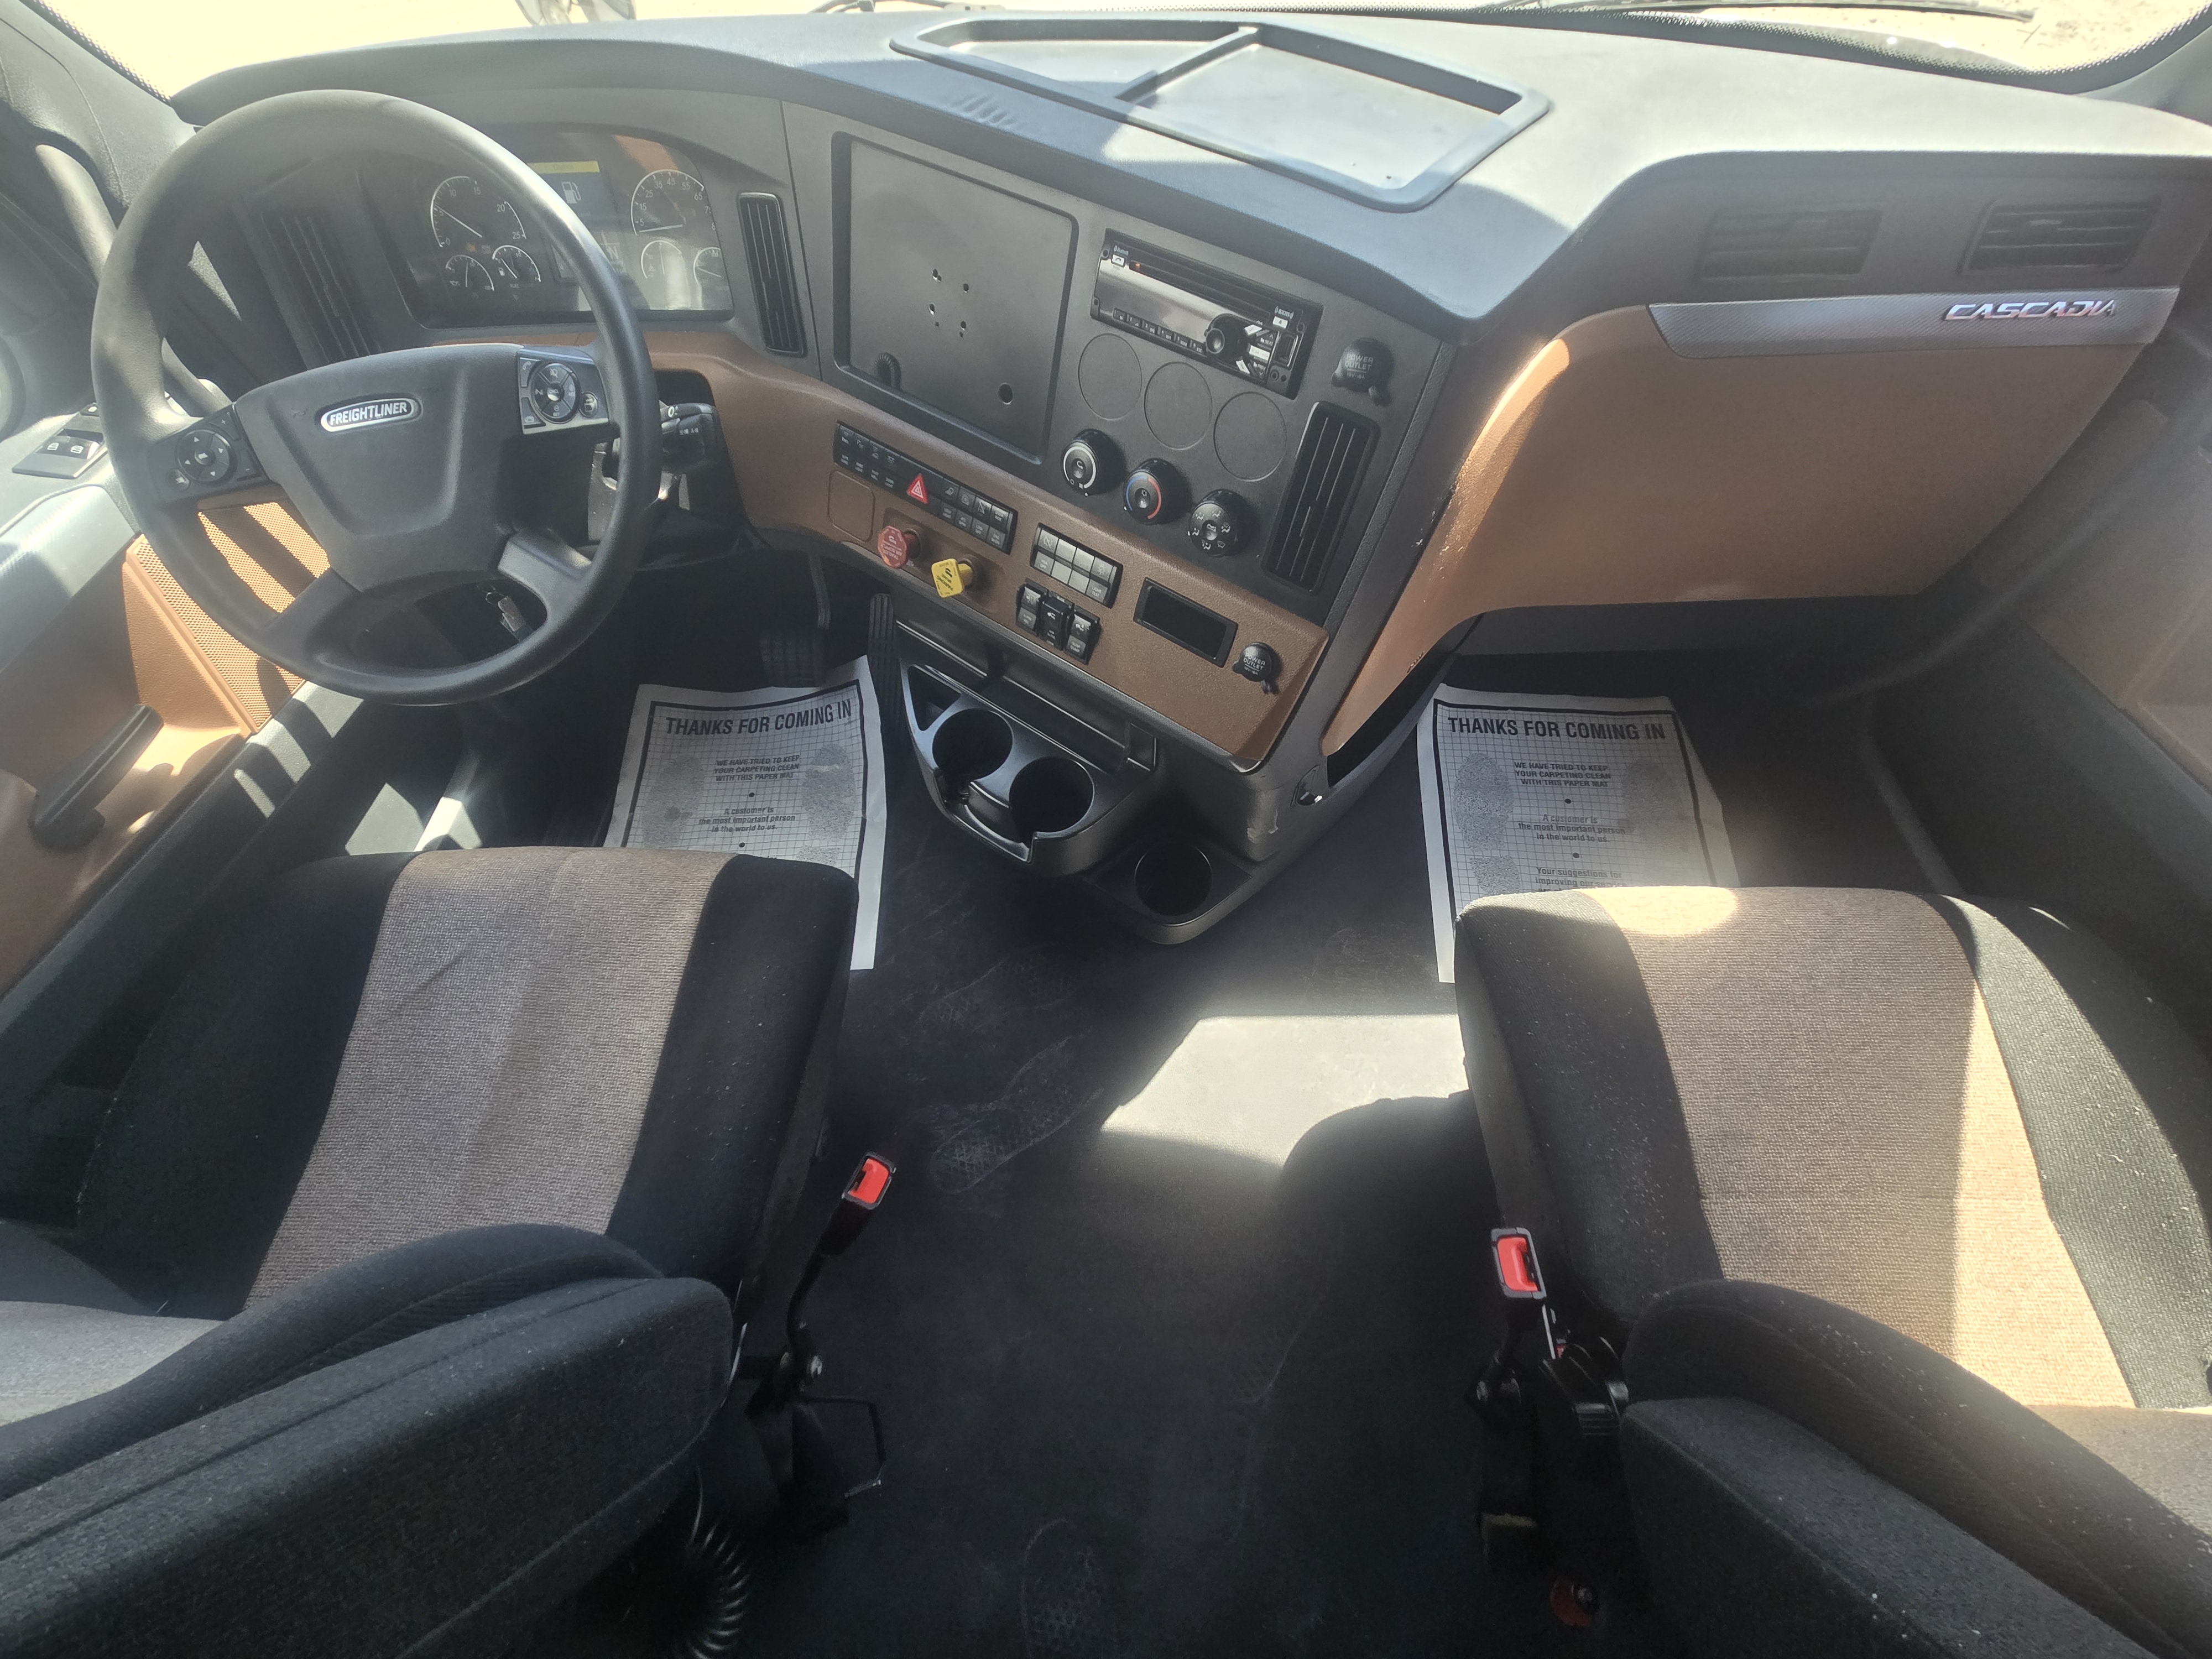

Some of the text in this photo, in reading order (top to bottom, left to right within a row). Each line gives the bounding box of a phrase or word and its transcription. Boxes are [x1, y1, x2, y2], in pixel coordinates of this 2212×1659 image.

[655, 181, 663, 189] 35
[473, 187, 481, 195] 15
[645, 190, 654, 198] 25
[694, 192, 703, 201] 65
[497, 204, 505, 212] 20
[640, 218, 644, 226] 5
[1943, 300, 2115, 320] CASCADIA
[1346, 353, 1373, 364] POWER
[1345, 361, 1371, 371] OUTLET
[330, 402, 408, 425] FREIGHTLINER
[1244, 658, 1264, 670] OUTLET
[1245, 653, 1265, 665] POWER
[666, 699, 851, 735] THANKS FOR COMING IN
[1448, 717, 1666, 739] THANKS FOR COMING IN
[1558, 869, 1608, 878] suggestions
[1535, 877, 1579, 887] improving
